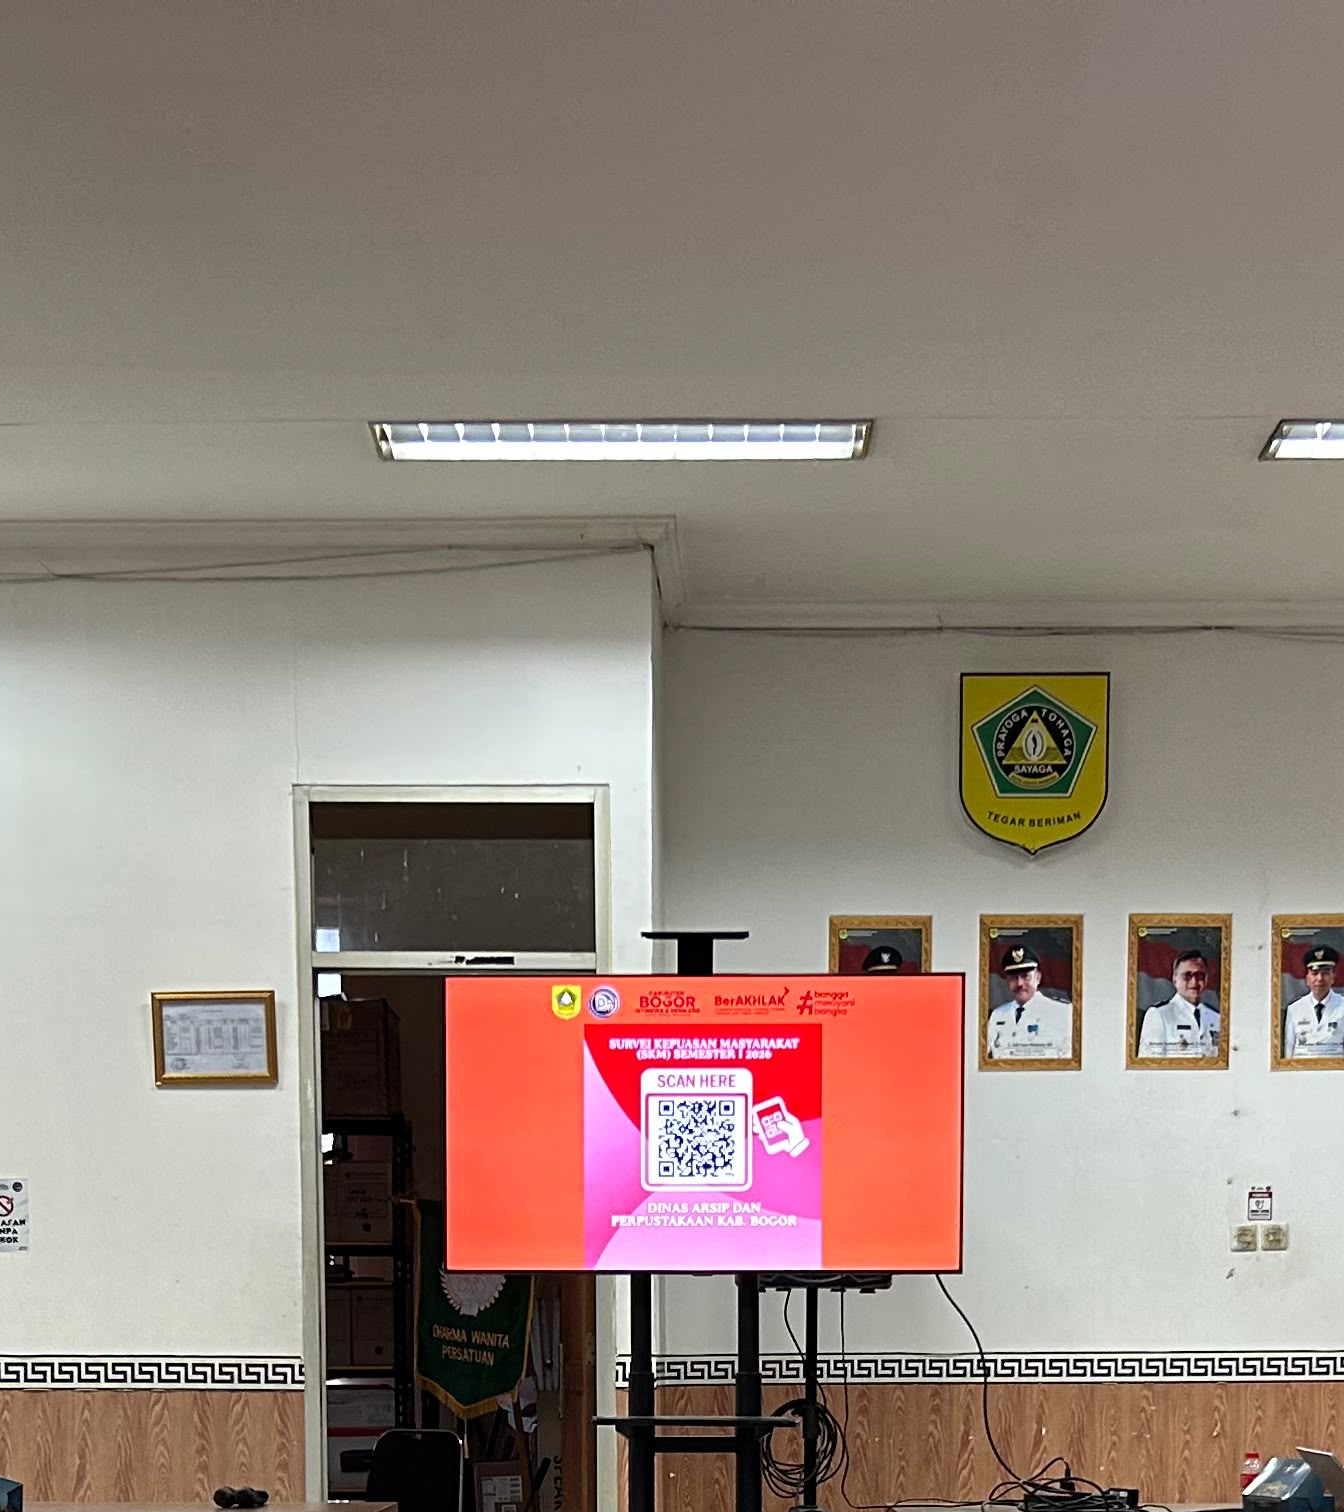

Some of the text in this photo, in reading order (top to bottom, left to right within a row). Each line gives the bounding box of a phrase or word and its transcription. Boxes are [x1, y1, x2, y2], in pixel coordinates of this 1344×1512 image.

[996, 708, 1072, 757] PRAYOGA TOHAGA
[1014, 764, 1053, 774] SAYAGA
[987, 811, 1082, 828] TEGAR BERIMAN
[639, 996, 696, 1009] BOGOR
[714, 995, 785, 1006] BerAKHLAK
[609, 1038, 800, 1050] SURVEI KEPUASAN MASYARAKAT
[636, 1049, 671, 1061] (SKM)
[673, 1049, 735, 1060] SEMESTER
[657, 1074, 736, 1088] SCAN HERE
[647, 1202, 761, 1214] DINAS ARSIP DAN
[611, 1215, 797, 1228] PERPUSTAKAAN KAB. BOGOR
[432, 1324, 510, 1349] DHARMA WANITA
[441, 1344, 495, 1367] PERSATUAN
